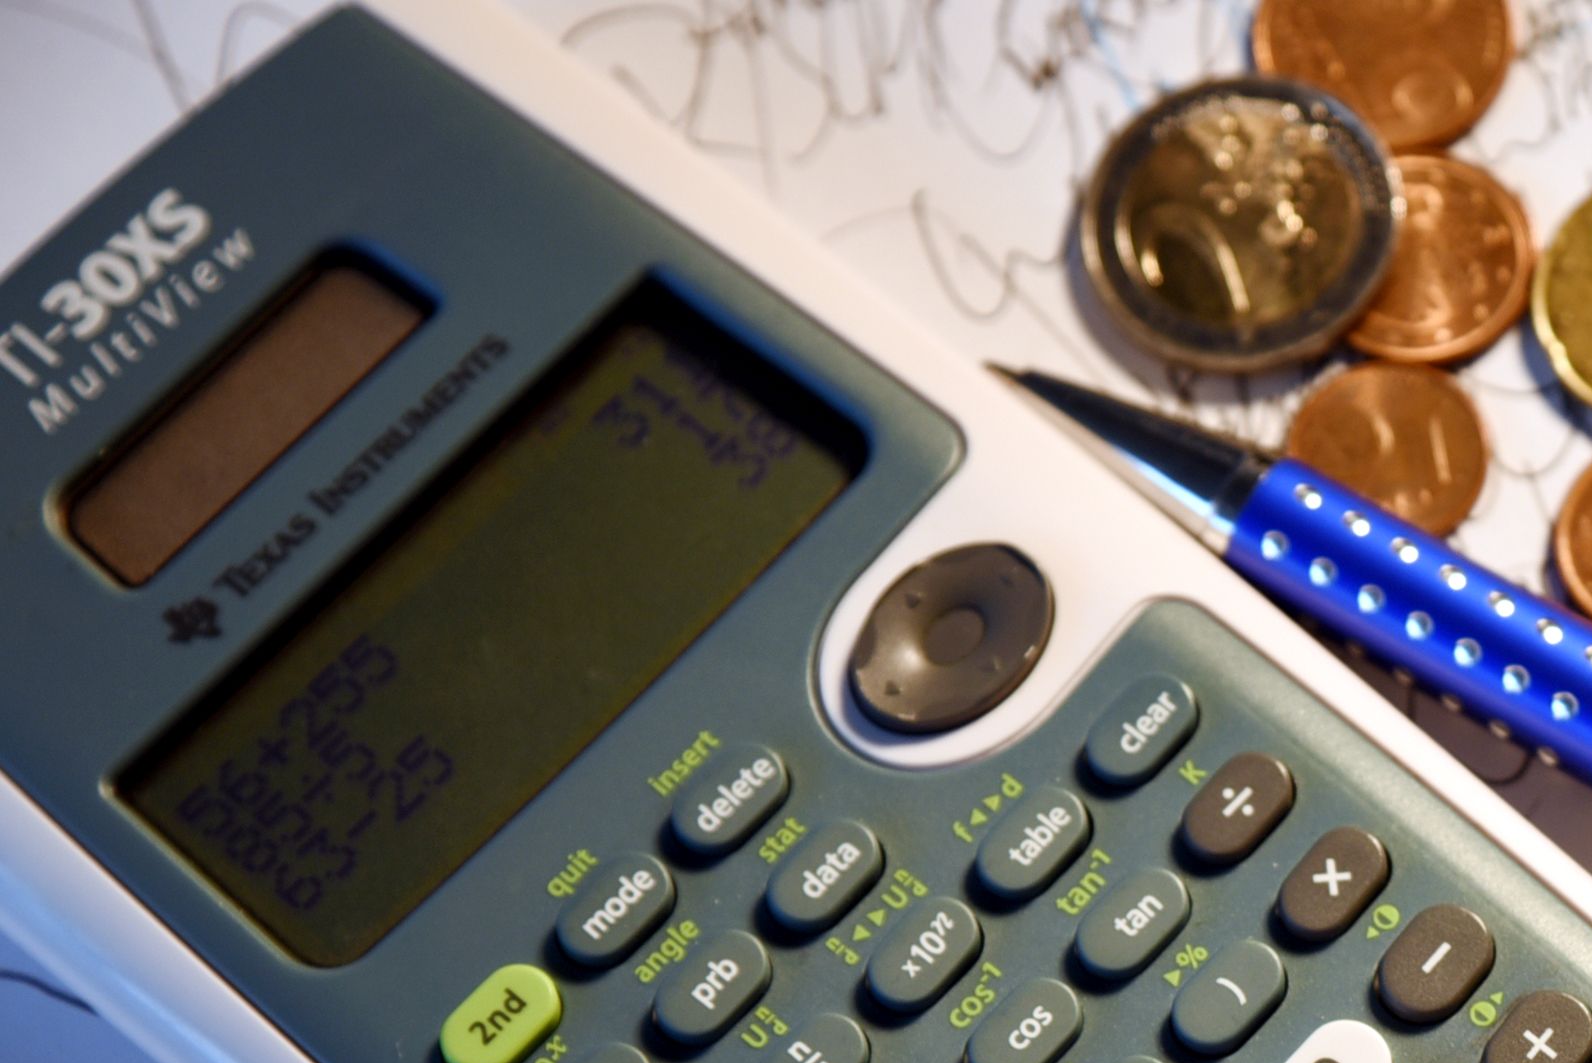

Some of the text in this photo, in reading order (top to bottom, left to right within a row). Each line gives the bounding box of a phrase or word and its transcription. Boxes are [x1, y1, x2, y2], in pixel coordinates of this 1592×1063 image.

[28, 227, 254, 434] MultiView
[212, 333, 510, 599] TEXAS INSTRUMENTS
[1120, 691, 1178, 755] clear
[647, 729, 722, 797] insert
[1179, 759, 1208, 786] K
[696, 756, 777, 833] delete
[758, 816, 809, 864] stat
[1008, 804, 1073, 867] table
[546, 848, 600, 899] quit
[802, 841, 862, 899] data
[581, 867, 658, 941] mode
[1113, 892, 1165, 938] tan
[634, 918, 700, 984] angle
[690, 956, 741, 1011] prb
[467, 988, 528, 1047] 2nd
[1008, 1004, 1054, 1051] cos
